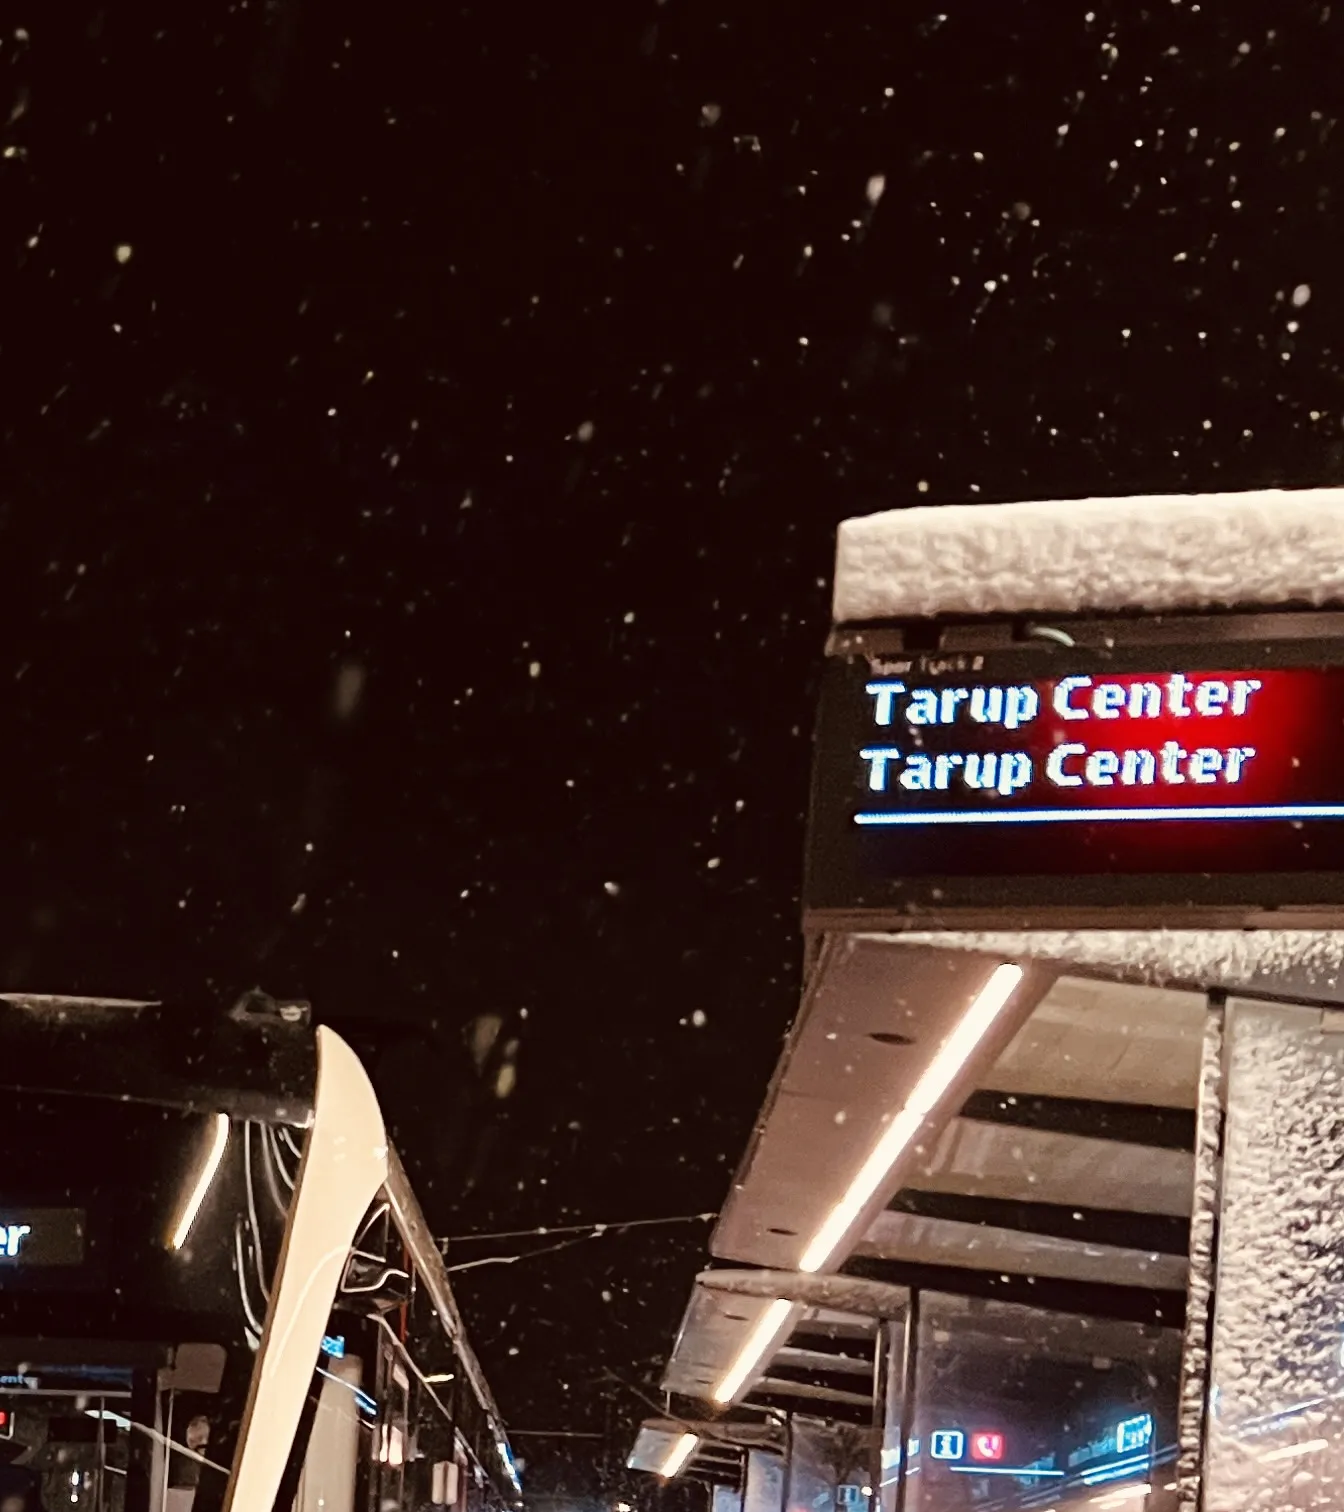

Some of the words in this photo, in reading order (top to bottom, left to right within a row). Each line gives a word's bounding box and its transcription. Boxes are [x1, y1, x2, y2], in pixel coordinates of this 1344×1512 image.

[865, 676, 1040, 730] Tarup
[1052, 673, 1263, 722] Center
[859, 743, 1034, 796] Tarup
[1045, 740, 1258, 788] Center
